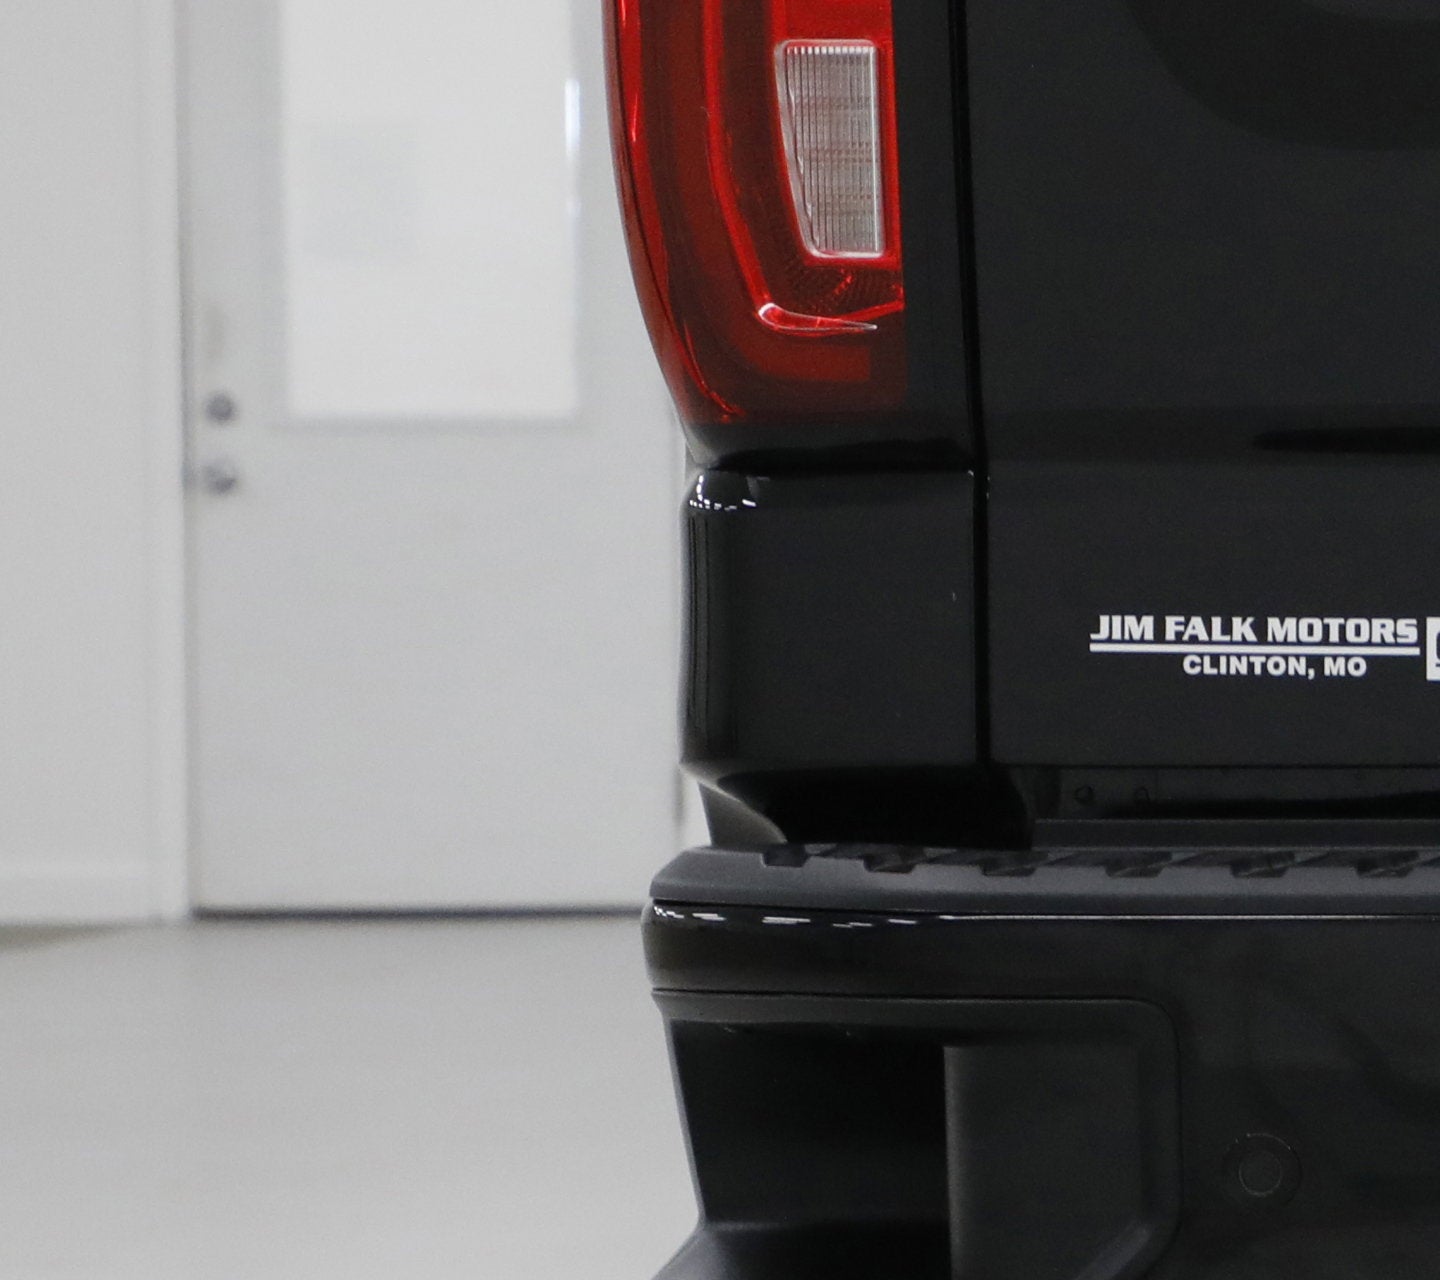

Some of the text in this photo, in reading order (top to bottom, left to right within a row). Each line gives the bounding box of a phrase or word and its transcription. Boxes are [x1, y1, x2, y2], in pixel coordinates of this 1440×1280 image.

[1090, 614, 1418, 644] JIM FALK MOTORS
[1182, 655, 1367, 680] CLINTON, MO
